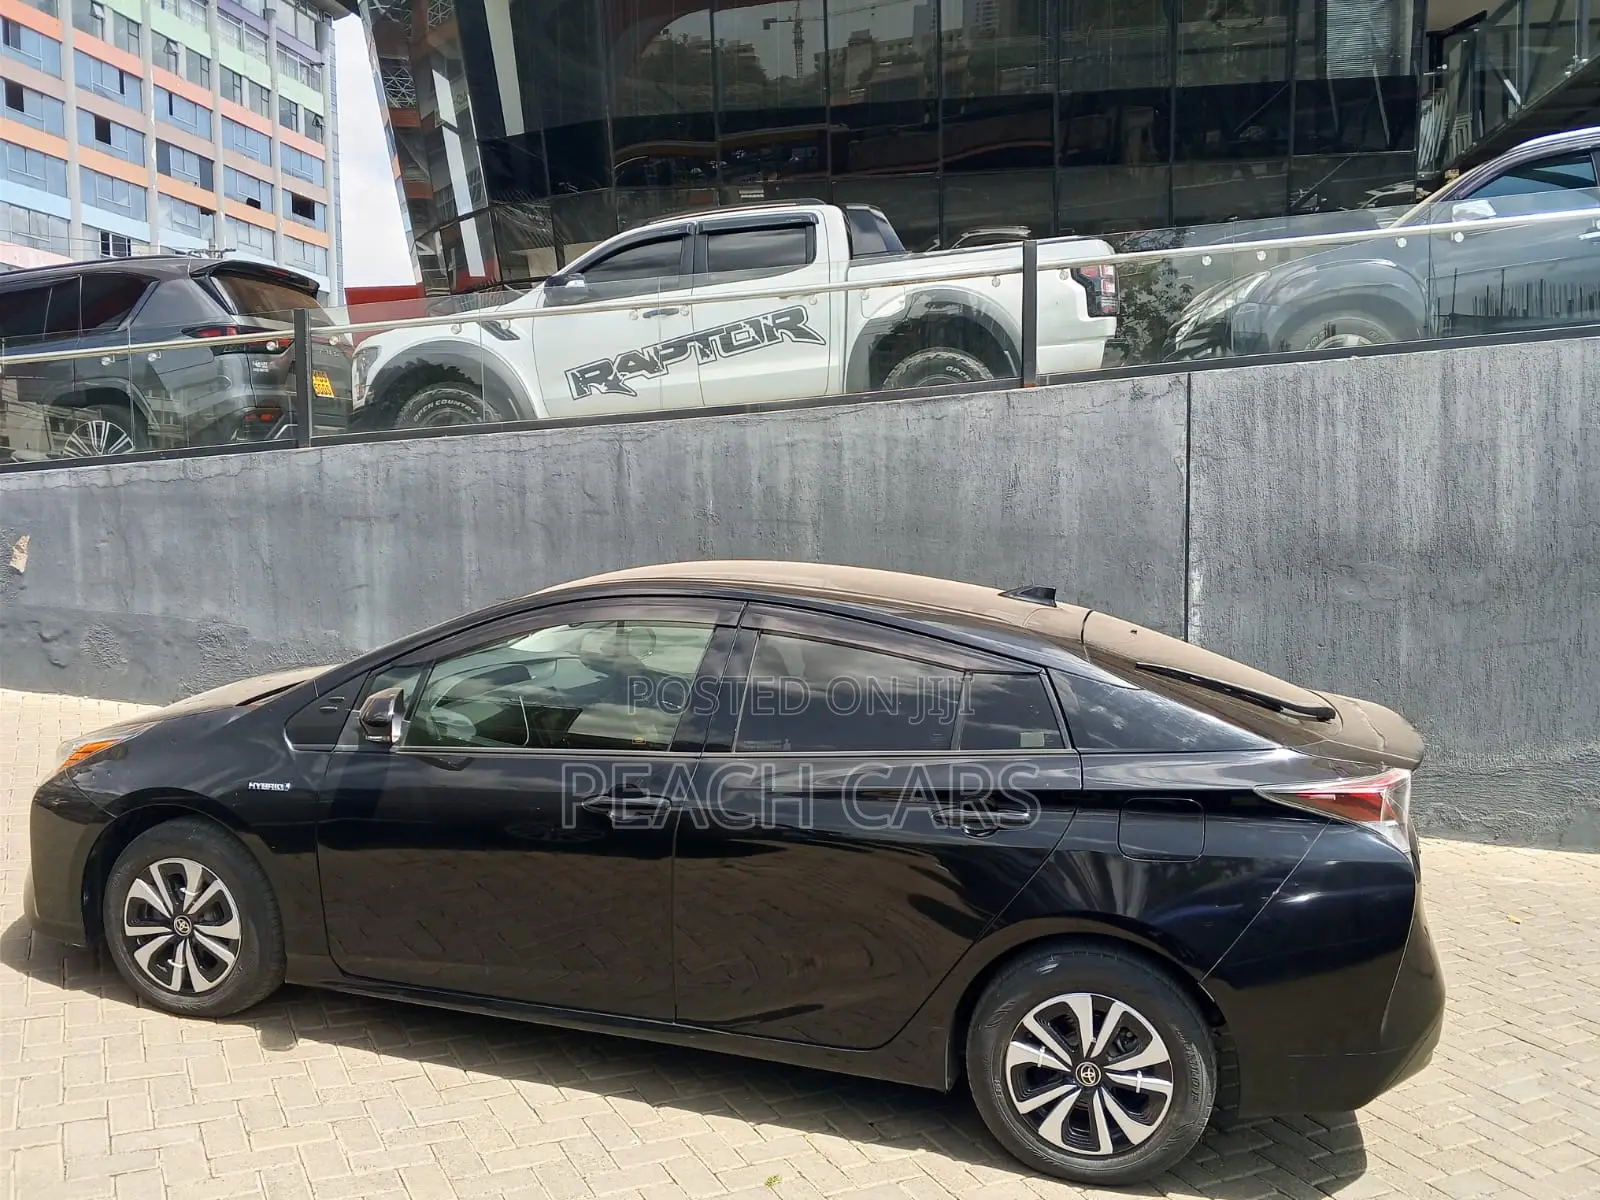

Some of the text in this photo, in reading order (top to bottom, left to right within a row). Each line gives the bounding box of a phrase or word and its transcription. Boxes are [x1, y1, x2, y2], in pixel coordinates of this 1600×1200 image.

[564, 304, 827, 401] RAPTOR
[435, 399, 478, 415] COUNTRY
[248, 781, 285, 791] HYBRID
